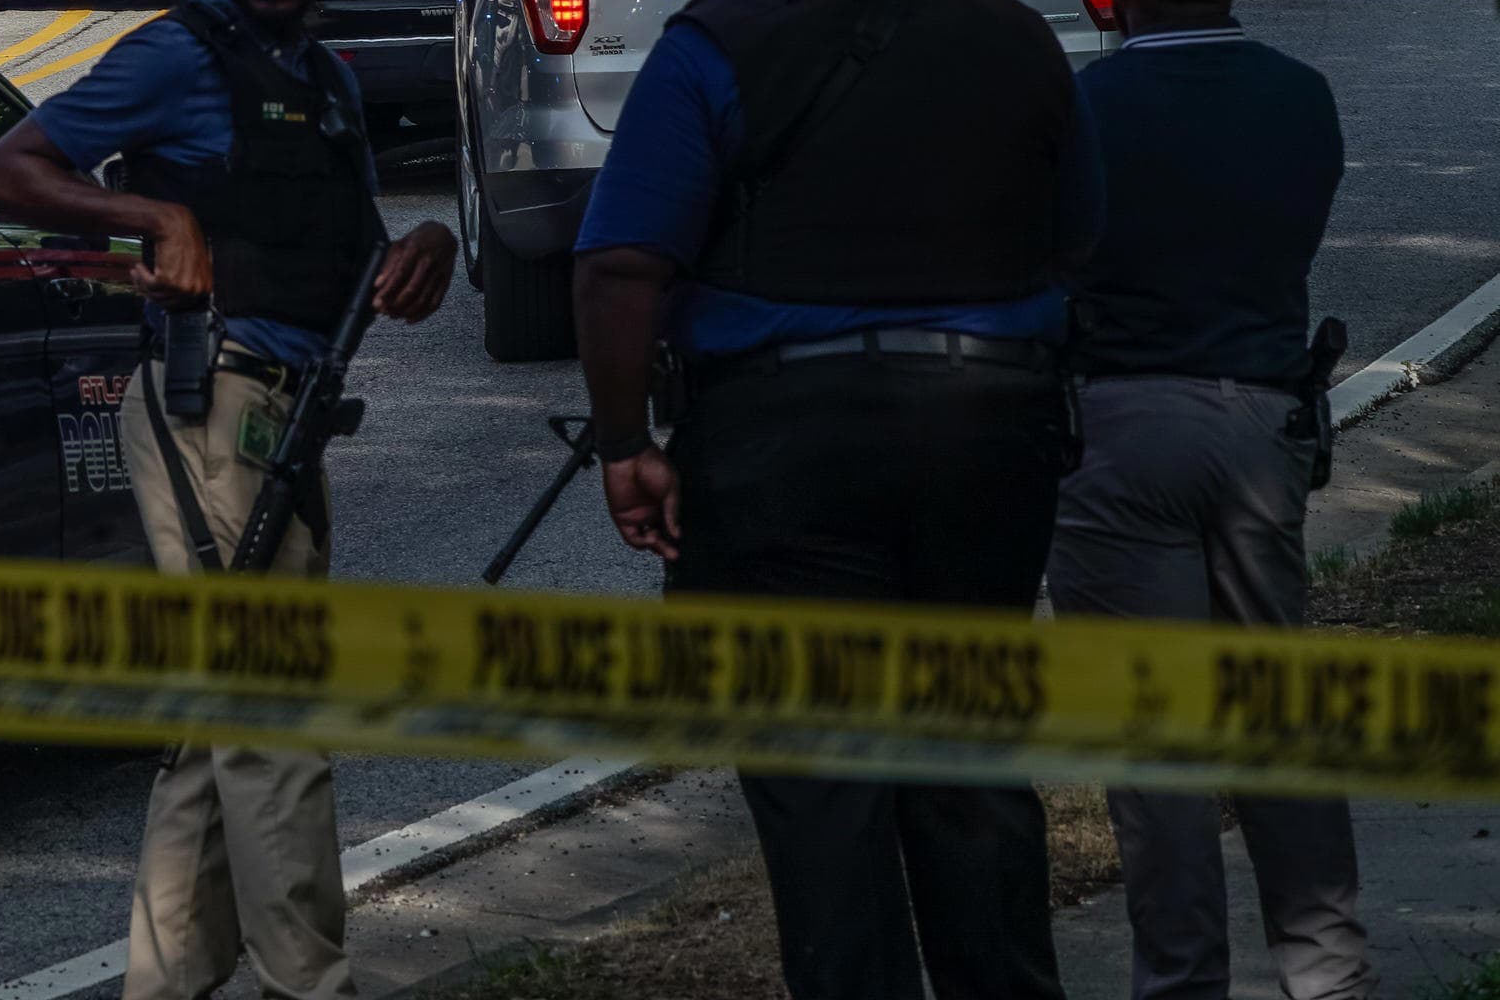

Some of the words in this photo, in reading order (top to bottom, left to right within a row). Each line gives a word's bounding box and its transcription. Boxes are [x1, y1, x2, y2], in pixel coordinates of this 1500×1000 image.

[78, 376, 132, 405] ATLA
[125, 591, 195, 673] NOT
[207, 597, 333, 682] CROSS
[475, 610, 615, 694] POLICE
[626, 616, 718, 703] LINE
[805, 626, 886, 712] NOT
[901, 632, 1047, 720] CROSS
[1213, 652, 1374, 742] POLICE
